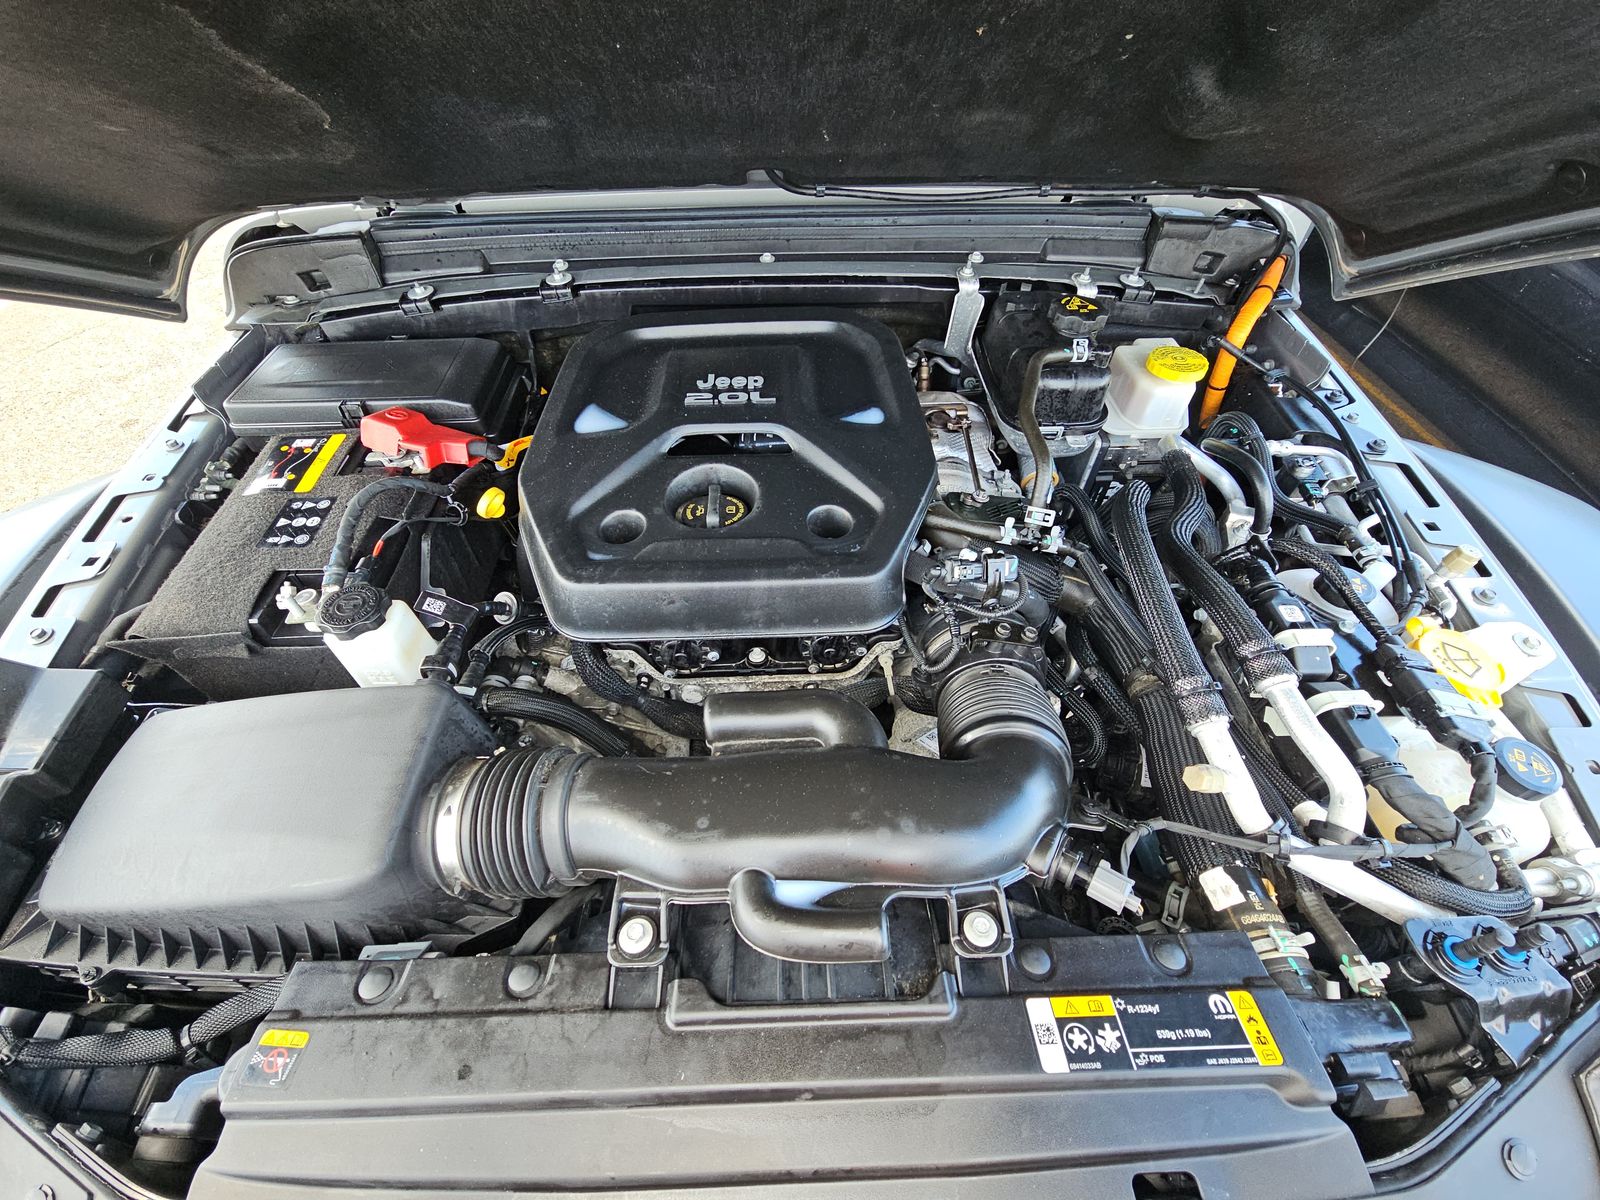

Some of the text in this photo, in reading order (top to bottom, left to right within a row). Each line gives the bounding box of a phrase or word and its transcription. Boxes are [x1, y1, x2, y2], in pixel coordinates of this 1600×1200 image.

[696, 373, 764, 390] Jeep
[684, 391, 777, 406] 2.0L
[1246, 889, 1264, 911] PHEV
[1127, 1003, 1160, 1016] R-1234yf
[1176, 1028, 1195, 1040] (1.19
[1149, 1054, 1166, 1064] POE
